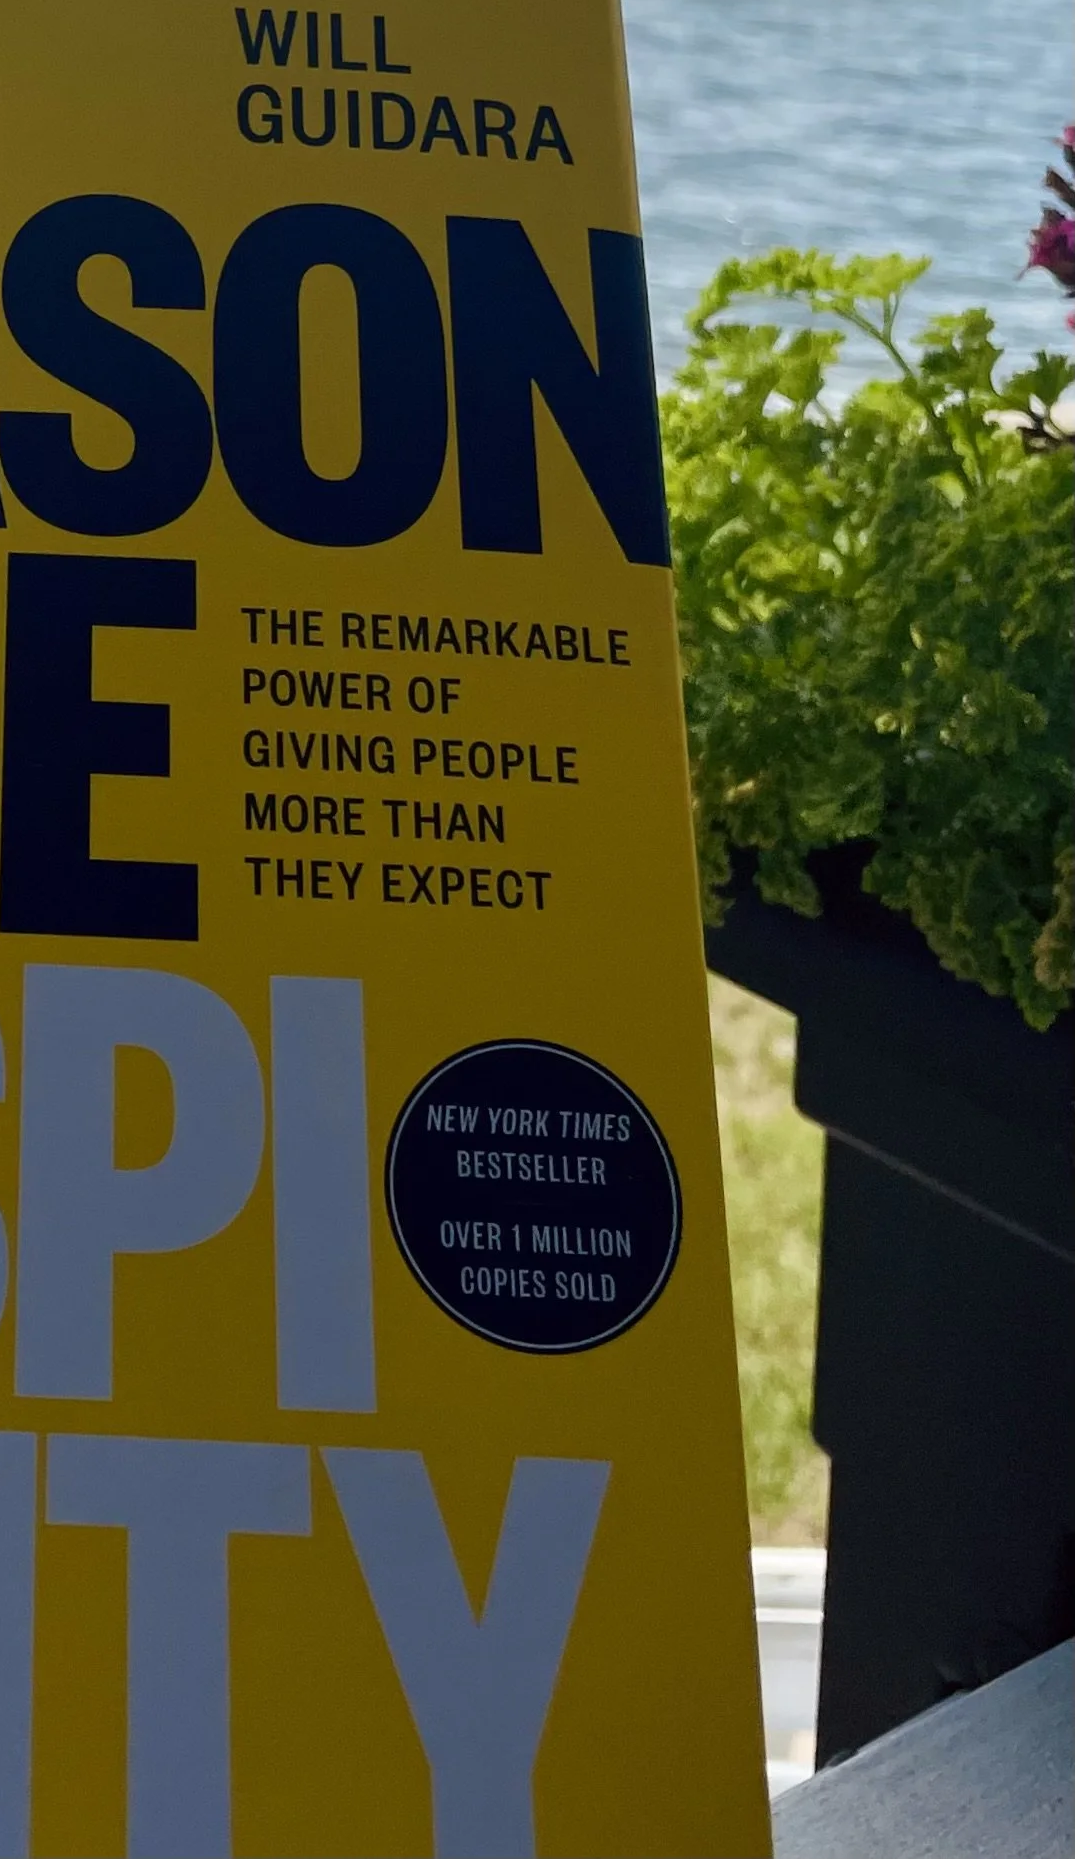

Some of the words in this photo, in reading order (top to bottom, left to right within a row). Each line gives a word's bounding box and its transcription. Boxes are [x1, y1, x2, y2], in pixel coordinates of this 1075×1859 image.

[234, 7, 412, 74] WILL
[236, 83, 574, 166] GUIDARA
[241, 607, 324, 647] THE
[340, 612, 632, 667] REMARKABLE
[242, 668, 392, 712] POWER
[407, 676, 461, 714] OF
[242, 729, 395, 774] GIVING
[412, 738, 580, 784] PEOPLE
[244, 792, 366, 836] MORE
[381, 799, 505, 843] THAN
[244, 857, 364, 900] THEY
[381, 863, 552, 910] EXPECT
[426, 1104, 480, 1134] NEW
[488, 1107, 550, 1138] YORK
[559, 1110, 632, 1143] TIMES
[456, 1149, 607, 1186] BESTSELLER
[439, 1219, 502, 1251] OVER
[510, 1224, 522, 1252] 1
[531, 1224, 632, 1258] MILLION
[460, 1266, 547, 1298] COPIES
[554, 1271, 616, 1303] SOLD
